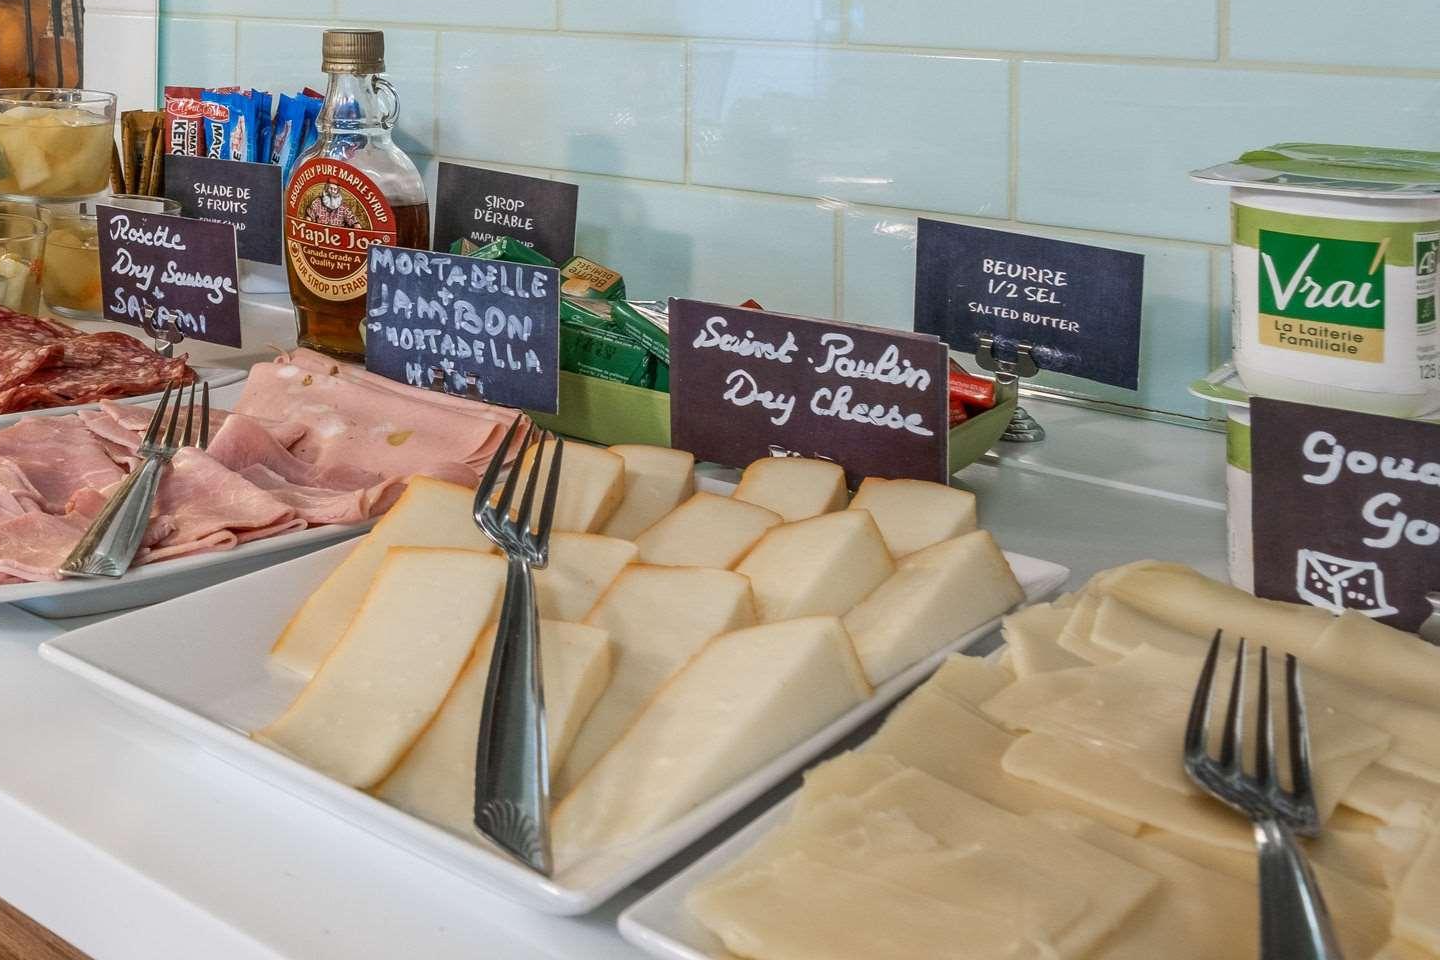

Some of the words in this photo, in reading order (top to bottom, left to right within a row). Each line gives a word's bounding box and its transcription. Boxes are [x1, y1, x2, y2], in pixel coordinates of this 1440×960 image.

[173, 121, 187, 156] KETC
[189, 122, 197, 156] TOMAT
[193, 182, 234, 197] SALADE
[236, 187, 251, 200] DE
[198, 197, 205, 208] 5
[207, 198, 248, 214] FRUITS
[290, 166, 315, 208] ABSOLUTELY
[316, 164, 337, 176] PURE
[339, 168, 368, 194] MAPLE
[366, 191, 388, 223] SYRUP
[484, 195, 525, 212] SIROP
[110, 214, 186, 251] Rosette
[290, 220, 341, 246] Maple
[474, 207, 534, 230] D'ÉRABLE
[302, 245, 327, 259] Canada
[328, 252, 353, 262] Grade
[353, 255, 361, 263] A
[309, 256, 335, 270] Quality
[111, 247, 155, 291] Dry
[160, 260, 238, 305] Sausage
[296, 258, 307, 277] PUR
[307, 274, 330, 293] SIROP
[332, 272, 368, 295] D'ERAB
[370, 247, 548, 299] MORTADELLE
[983, 258, 1068, 287] BEURRE
[1261, 237, 1391, 310] Vrai
[988, 279, 1018, 298] 1/2
[1024, 286, 1062, 304] SEL
[368, 283, 533, 342] JAMBON
[968, 301, 1019, 320] SALTED
[1022, 312, 1080, 333] BUTTER
[1274, 319, 1293, 333] La
[1299, 323, 1365, 343] Laiterie
[1279, 332, 1359, 355] Familiale
[386, 326, 544, 374] MORTADELLA
[692, 316, 800, 364] Saint
[814, 332, 932, 392] Paulin
[722, 369, 796, 426] Dry
[810, 384, 935, 437] Cheese
